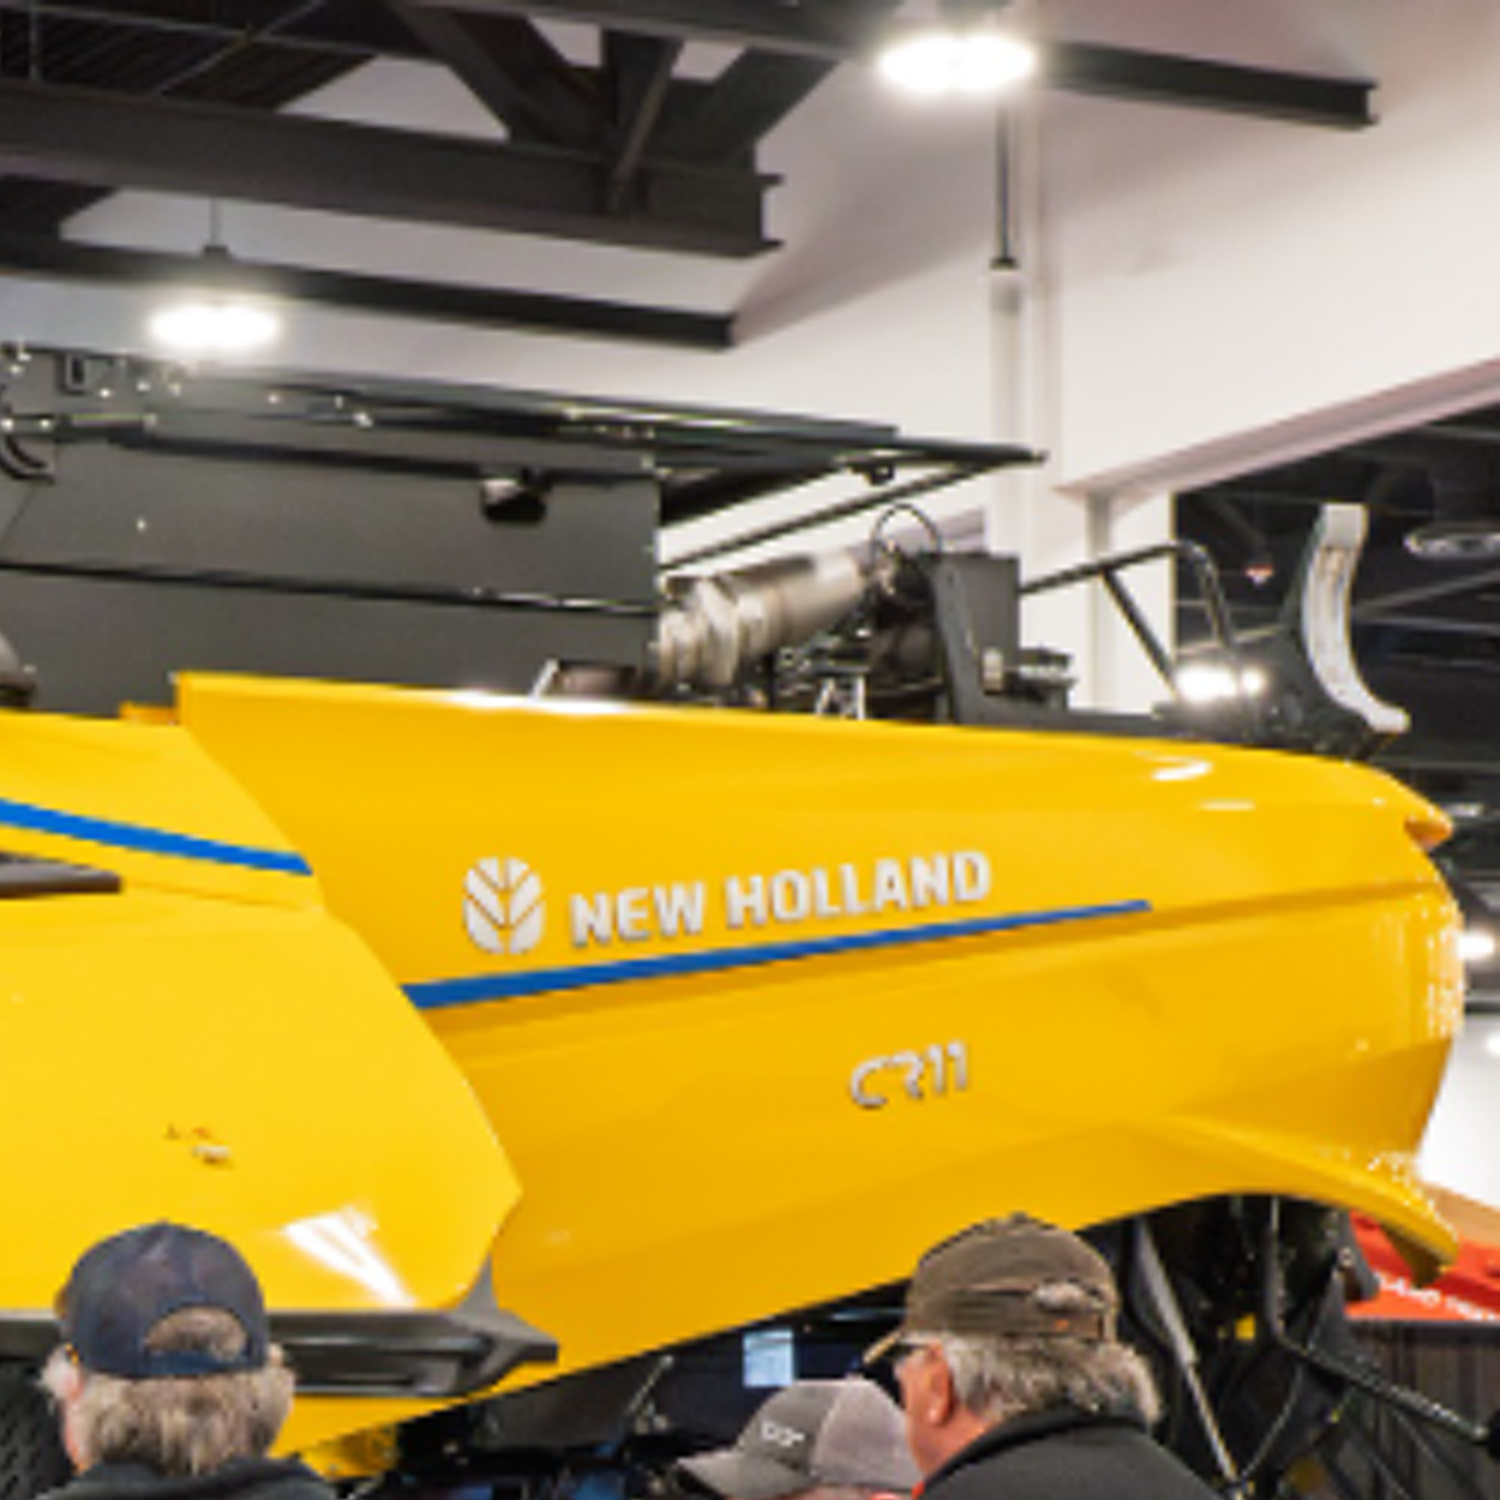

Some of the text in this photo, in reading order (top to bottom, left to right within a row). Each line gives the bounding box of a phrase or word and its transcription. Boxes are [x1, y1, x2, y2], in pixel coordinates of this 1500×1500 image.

[569, 850, 991, 948] NEW HOLLAND
[850, 1038, 968, 1110] CR11
